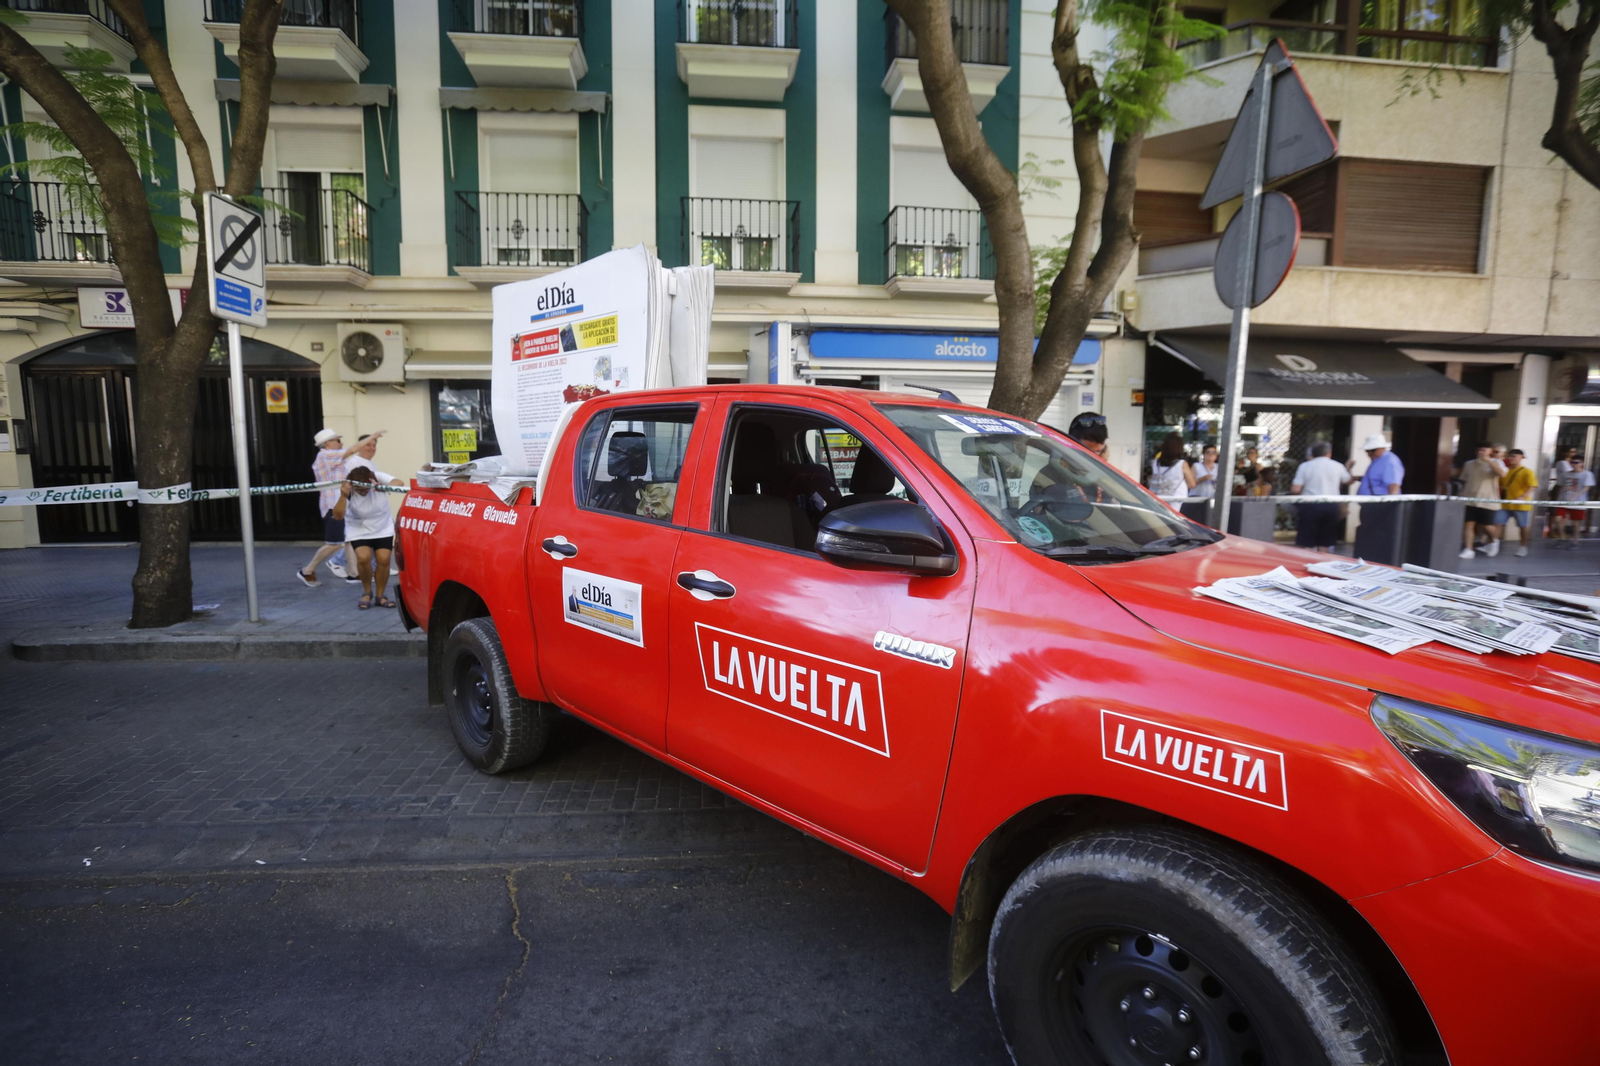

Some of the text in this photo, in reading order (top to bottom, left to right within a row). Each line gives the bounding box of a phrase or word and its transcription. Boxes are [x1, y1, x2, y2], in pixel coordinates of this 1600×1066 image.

[935, 341, 987, 357] alcosto
[44, 485, 123, 502] Fertiberia
[439, 499, 476, 517] #LaVuelta22
[483, 505, 518, 525] @lavuelta
[875, 631, 956, 668] HILUX
[713, 641, 867, 732] LA VUELTA
[1114, 723, 1267, 794] LA VUELTA
